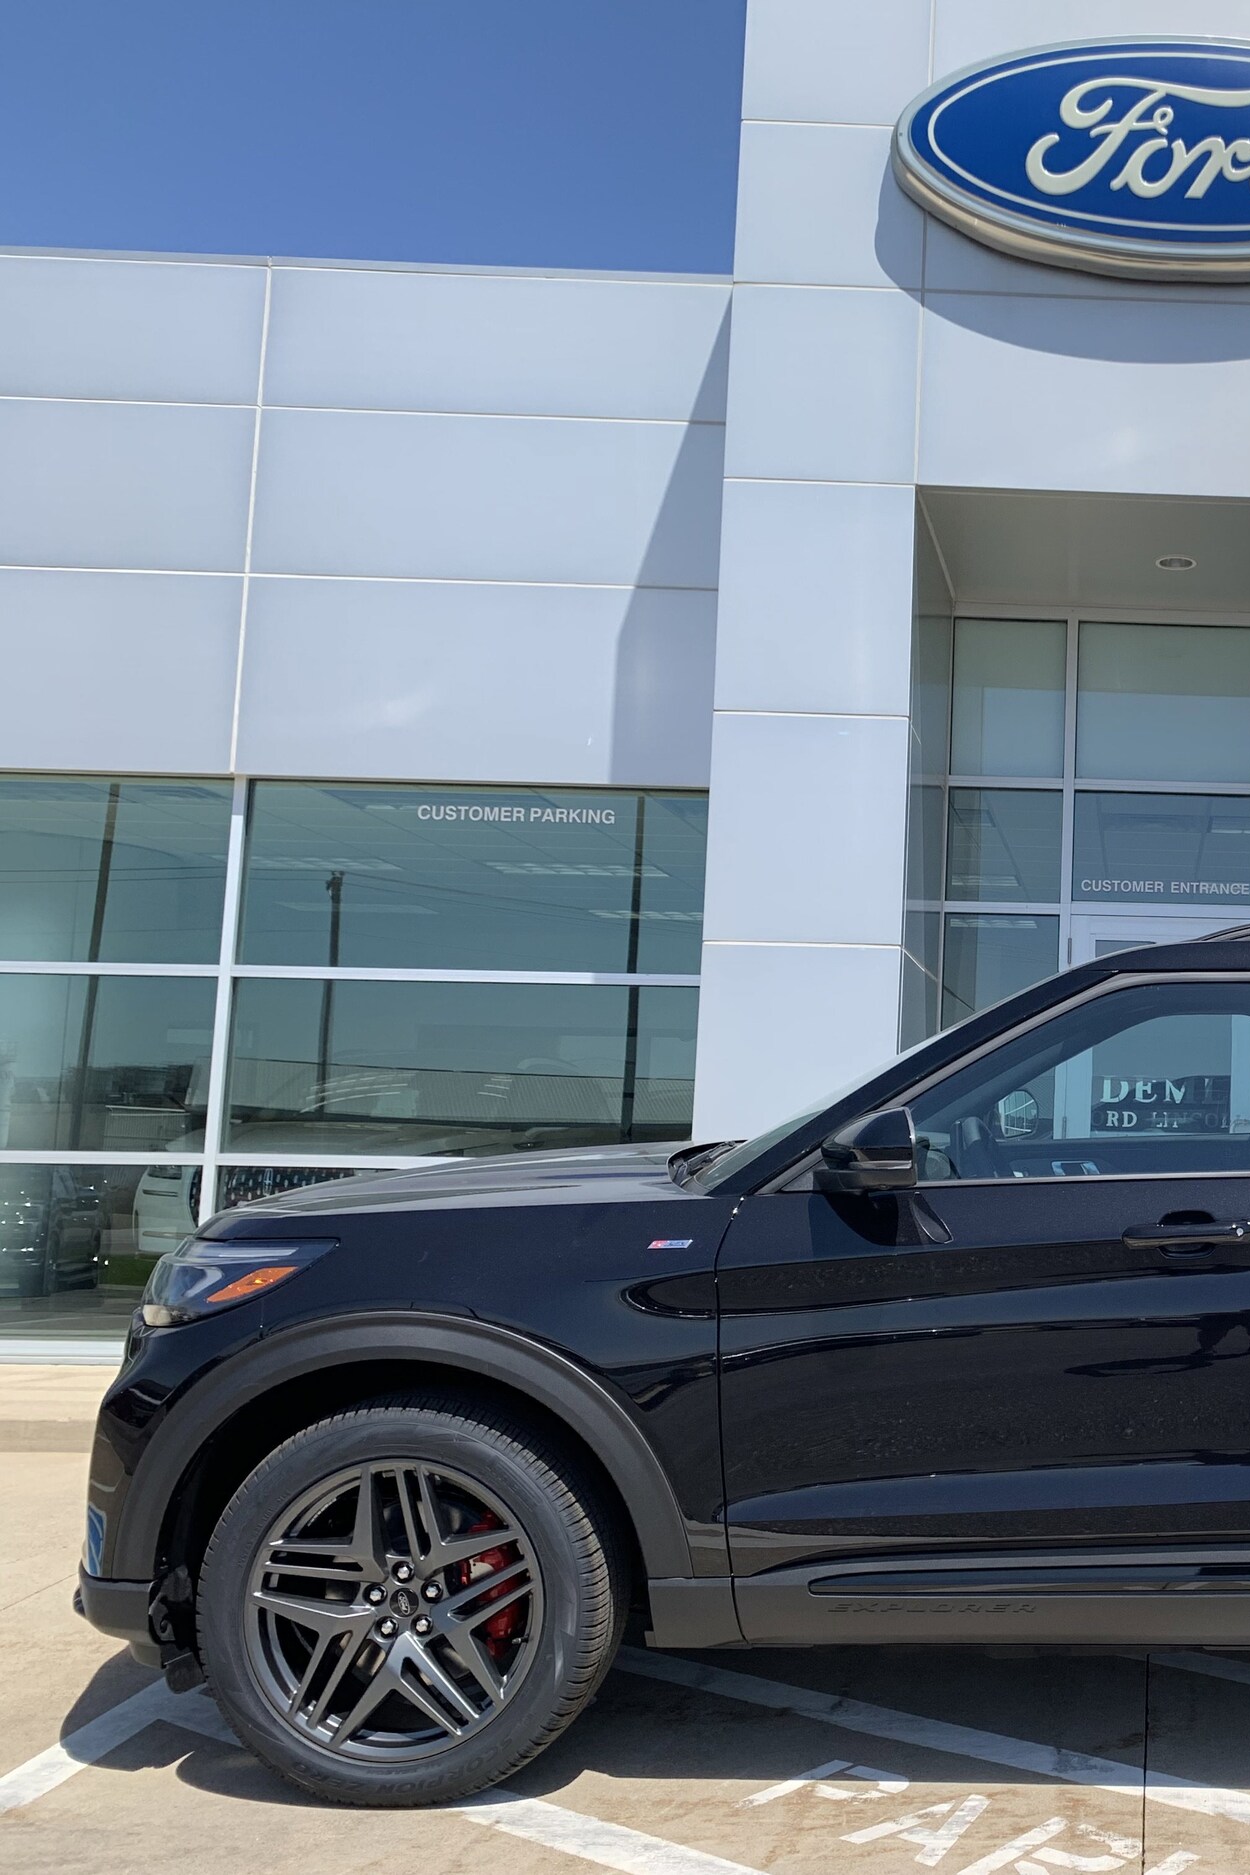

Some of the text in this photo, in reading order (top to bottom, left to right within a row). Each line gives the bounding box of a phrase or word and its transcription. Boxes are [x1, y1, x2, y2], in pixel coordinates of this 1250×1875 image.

[417, 804, 616, 825] CUSTOMER PARKING
[1080, 879, 1250, 895] CUSTOMER ENTRANCE
[826, 1602, 1038, 1614] EXPLORER
